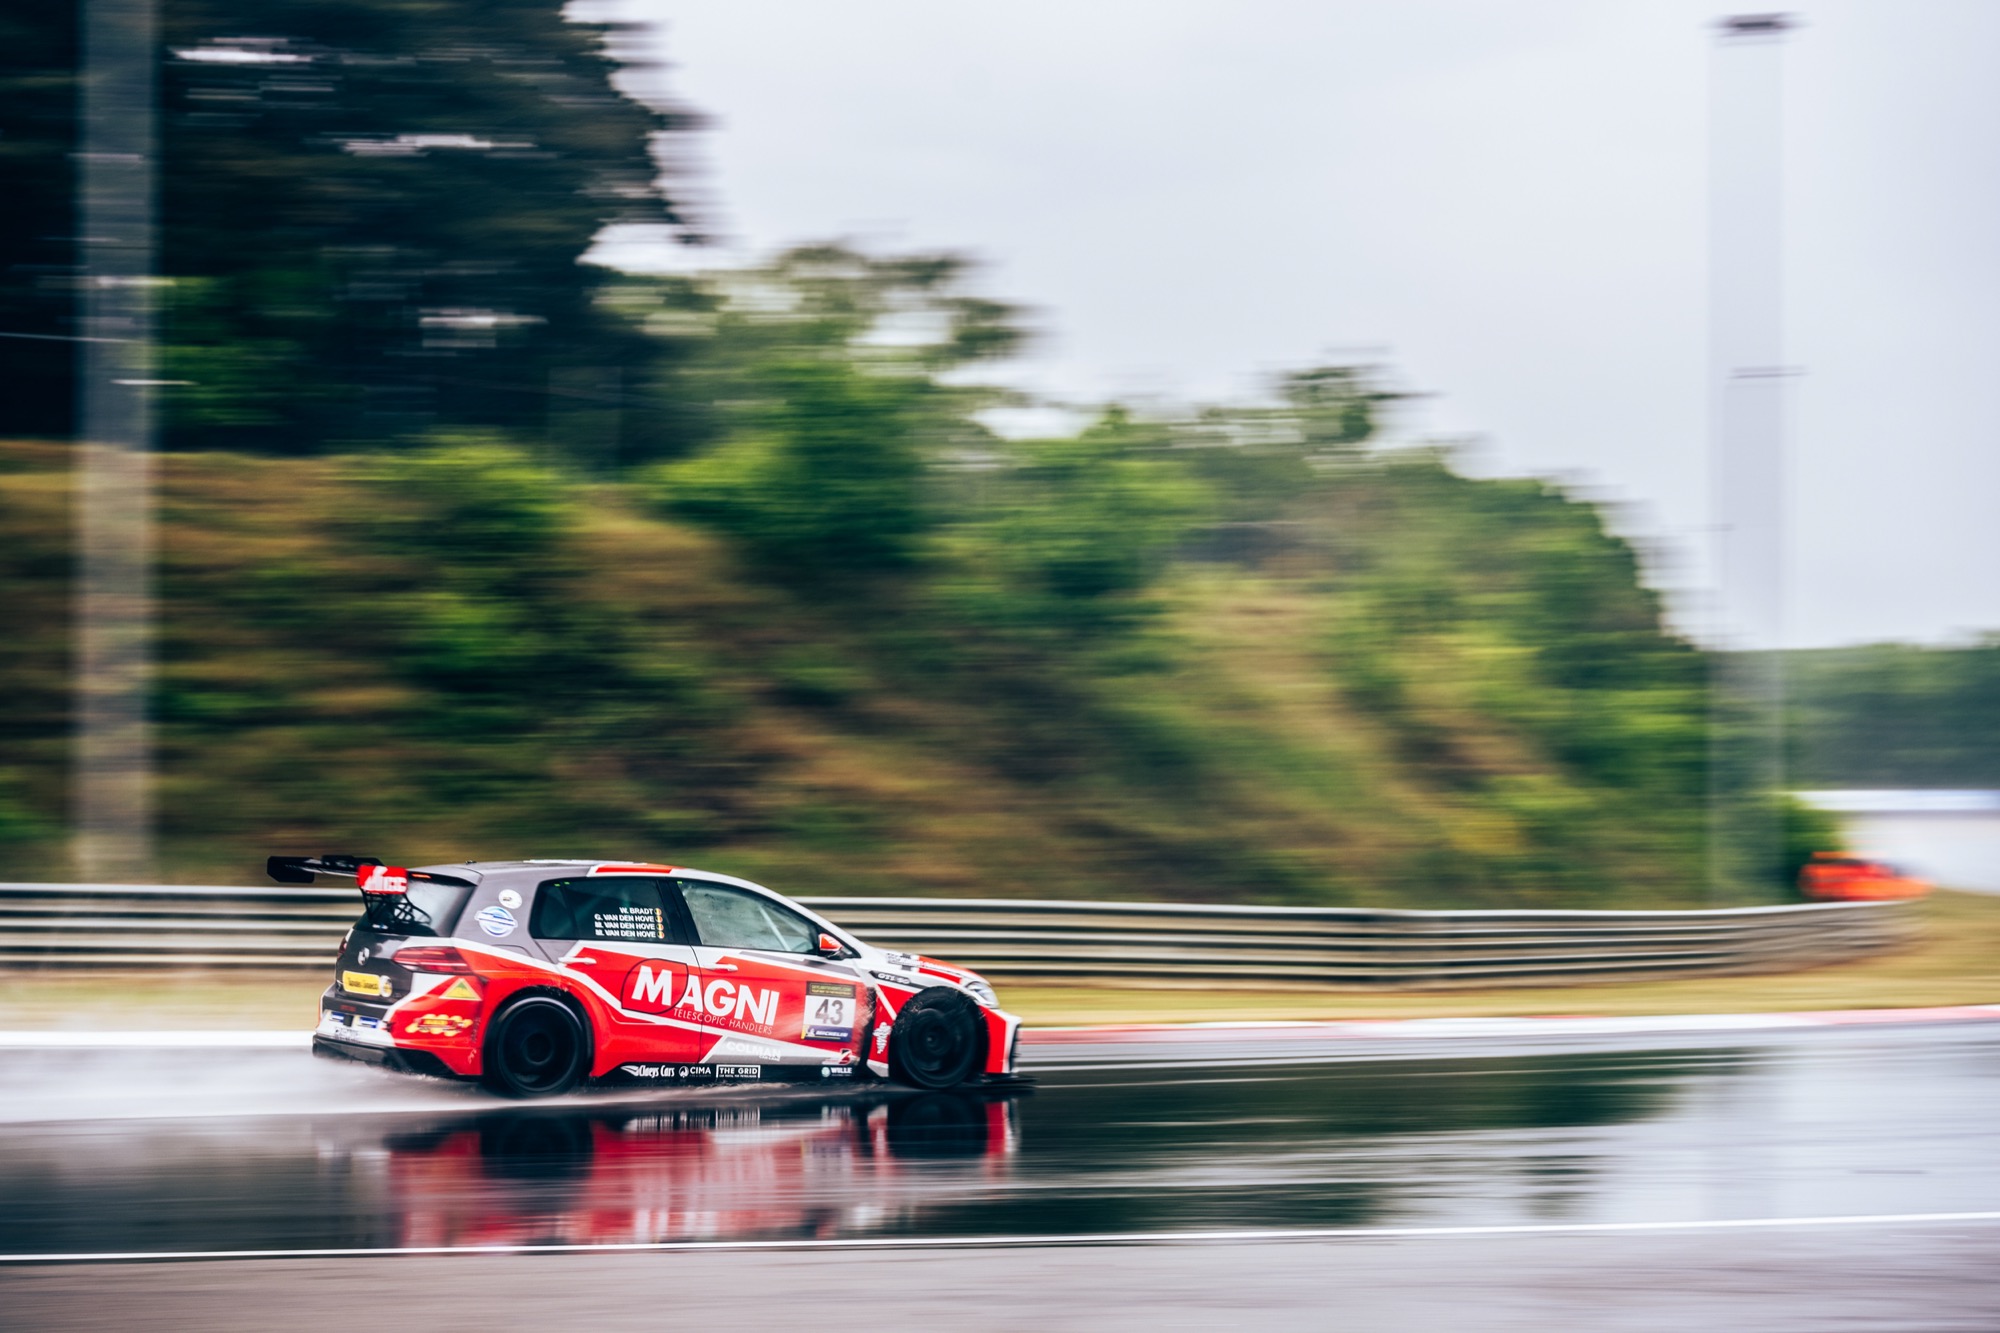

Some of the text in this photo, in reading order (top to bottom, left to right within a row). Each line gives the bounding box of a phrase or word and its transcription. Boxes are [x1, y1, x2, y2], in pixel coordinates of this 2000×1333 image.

[629, 907, 654, 915] BRADT
[619, 914, 634, 922] DEN
[635, 915, 655, 923] HOVE
[603, 921, 619, 929] VAN
[619, 922, 635, 930] DEN
[604, 929, 620, 937] VAN
[631, 965, 780, 1026] MAGNI
[815, 999, 843, 1025] 43
[673, 1008, 773, 1035] TELESCOPIC HANDLERS
[726, 1041, 782, 1059] COLMAN
[660, 1064, 675, 1077] Cars
[689, 1066, 712, 1075] CIMA
[737, 1067, 758, 1075] GRID
